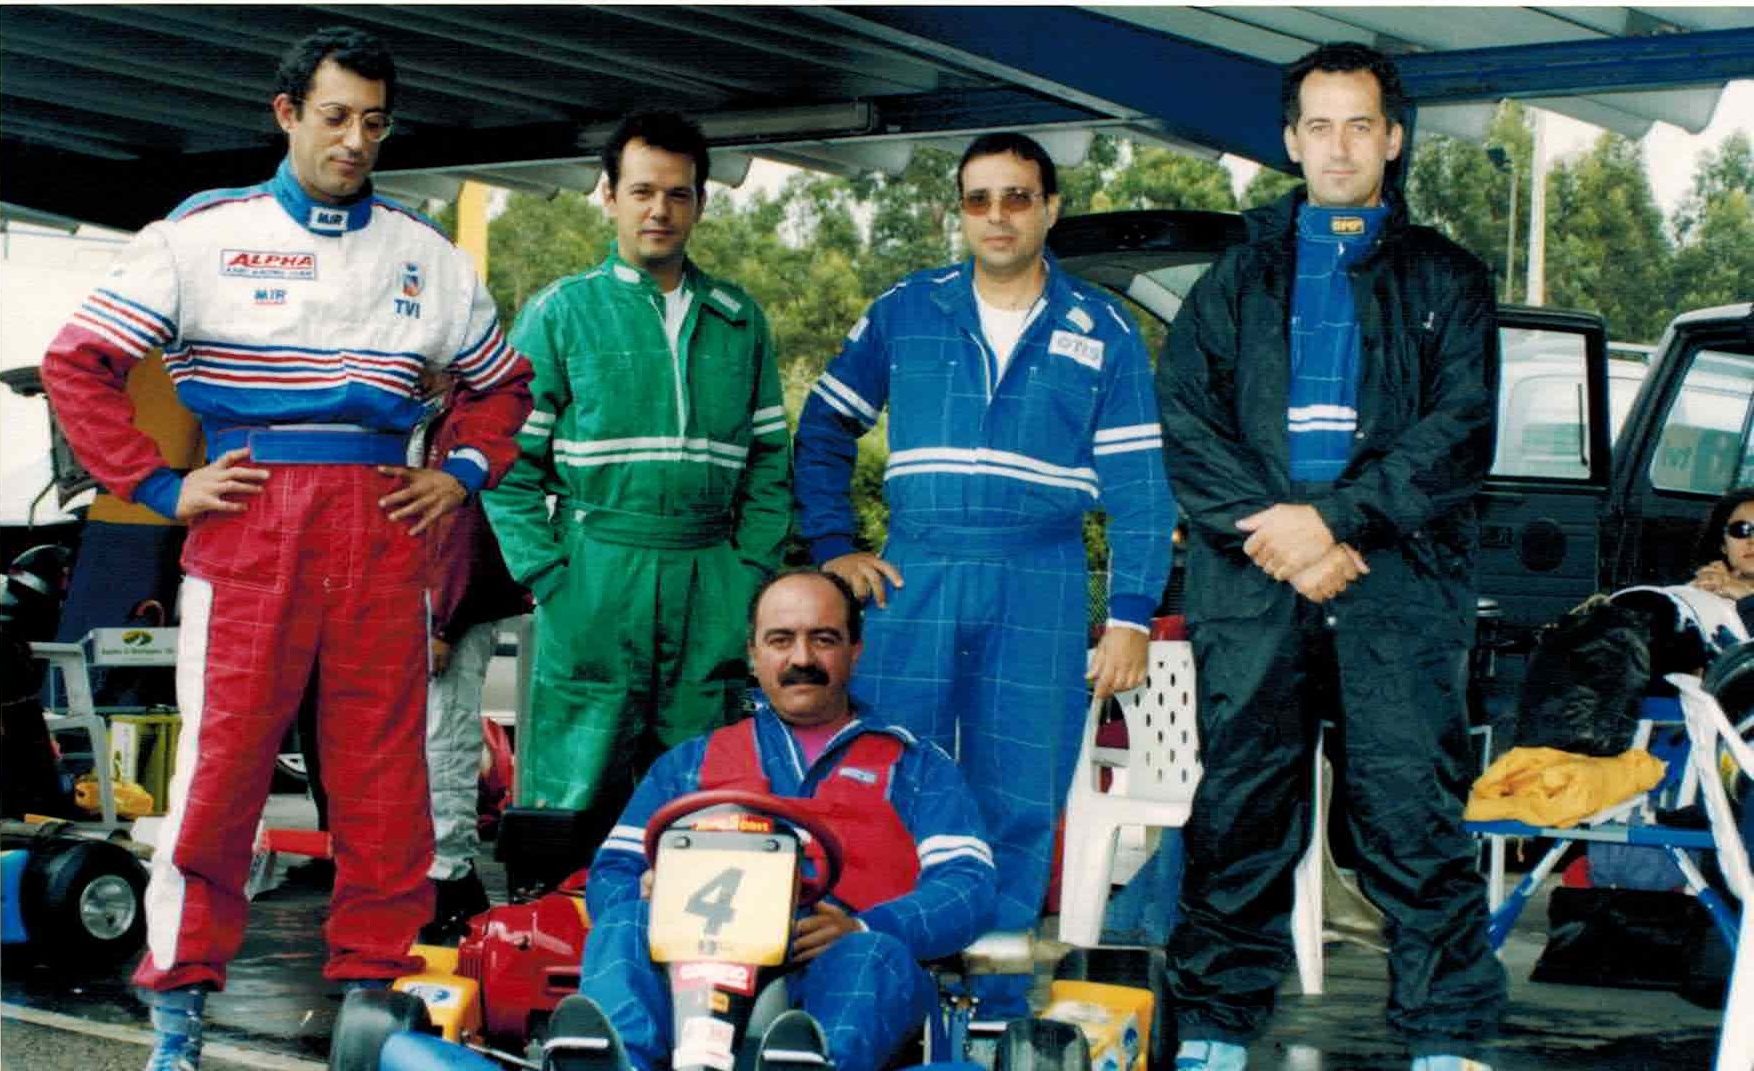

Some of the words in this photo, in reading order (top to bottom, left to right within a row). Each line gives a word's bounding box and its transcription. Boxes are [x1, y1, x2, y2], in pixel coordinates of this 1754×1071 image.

[228, 253, 313, 267] ALPHA
[394, 299, 420, 319] TVI
[685, 867, 744, 935] 4
